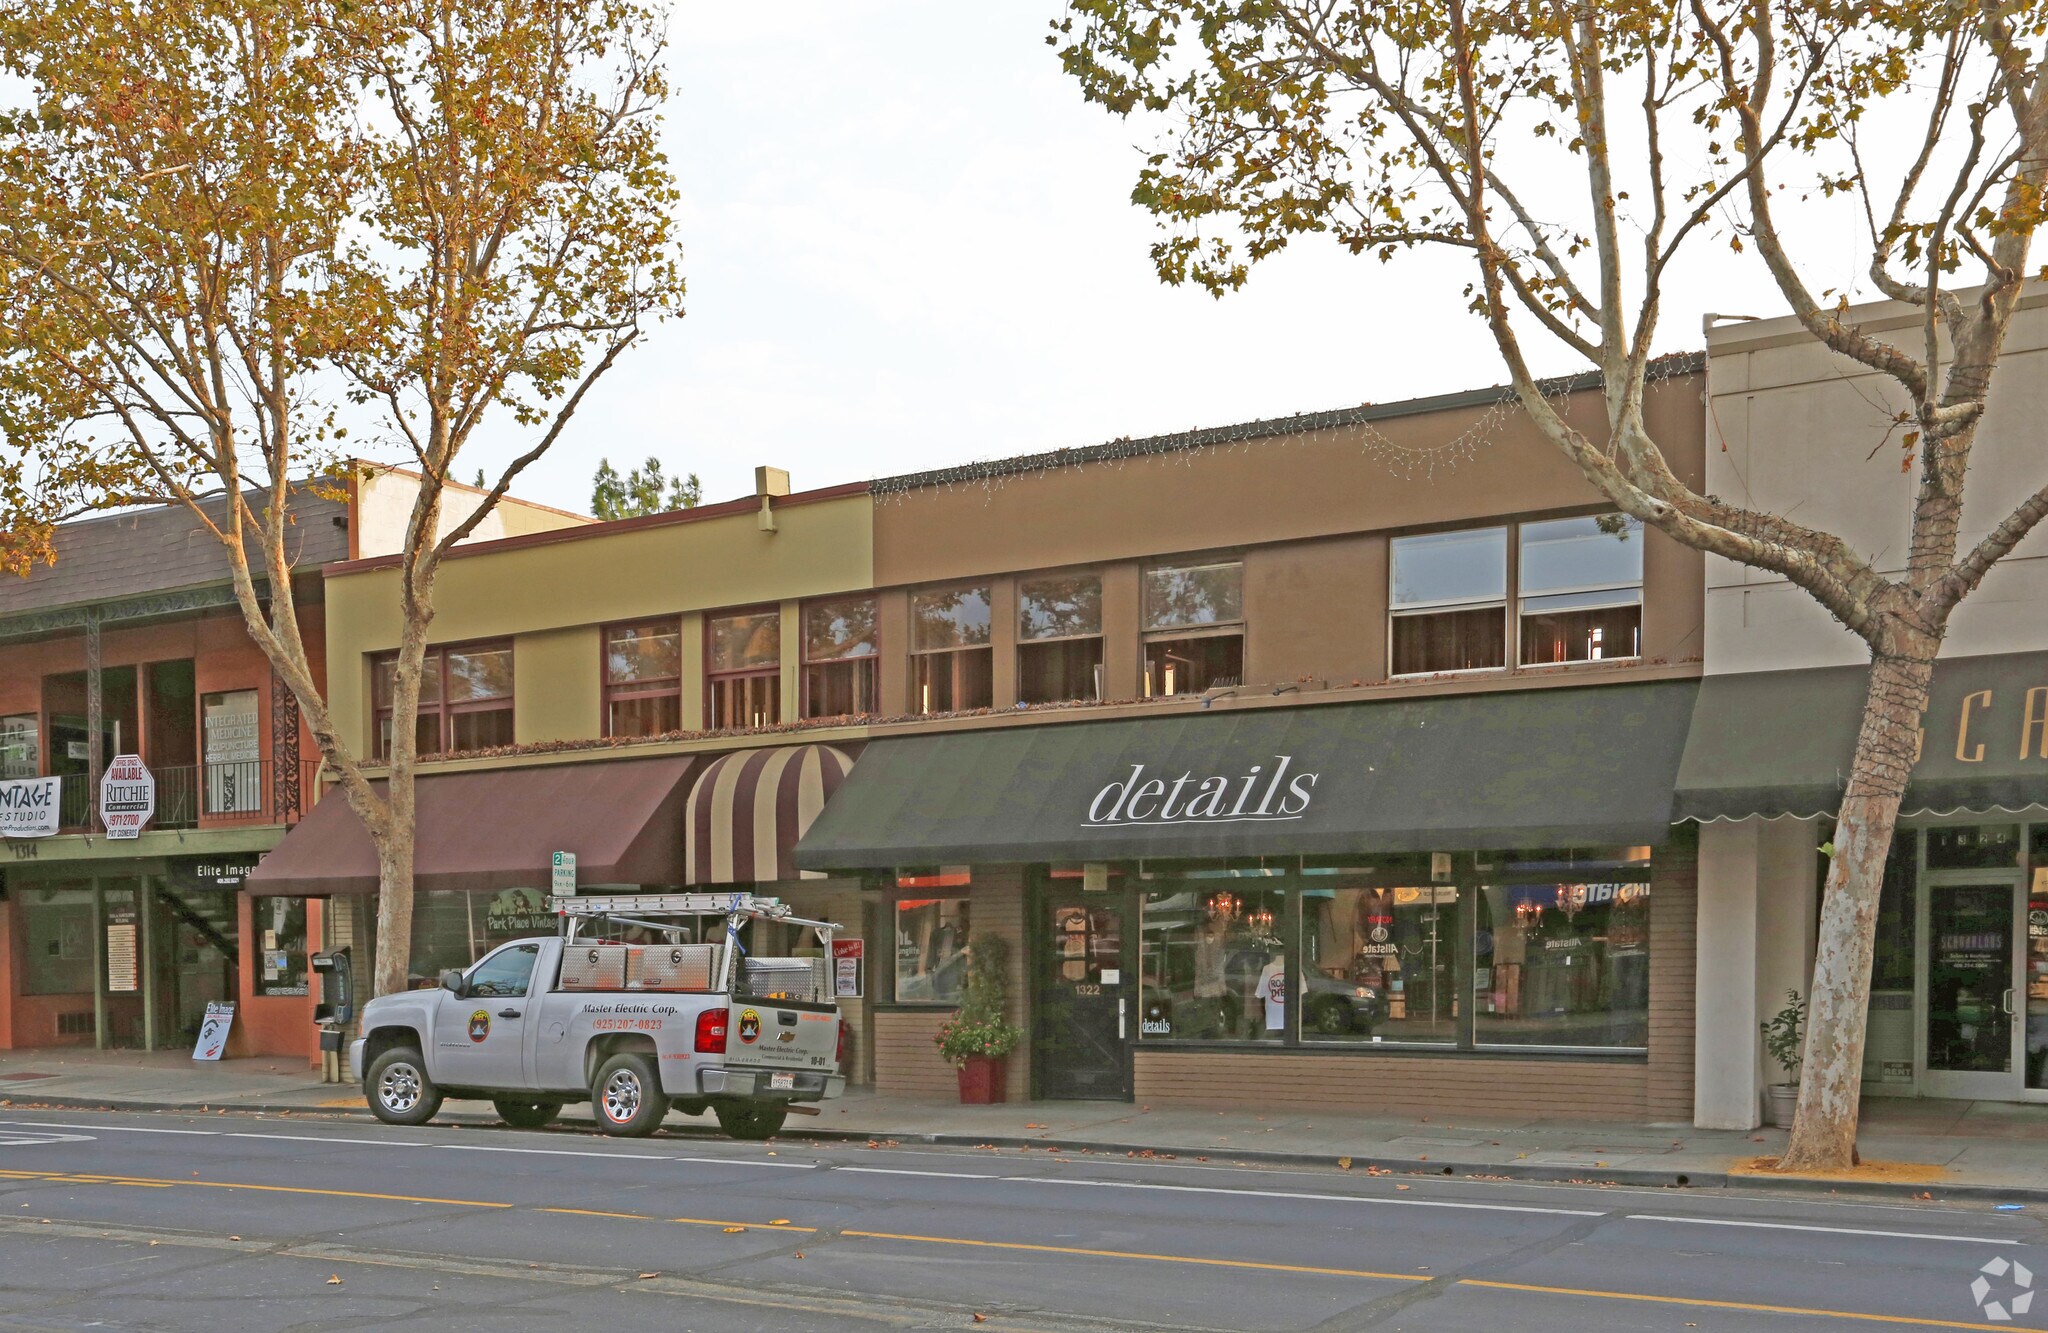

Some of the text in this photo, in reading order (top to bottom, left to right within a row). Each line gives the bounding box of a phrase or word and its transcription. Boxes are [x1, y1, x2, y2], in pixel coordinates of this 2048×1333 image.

[205, 713, 257, 728] INTEGRATED
[212, 727, 252, 740] MEDICINE
[207, 741, 258, 752] ACUPUNCTURE
[205, 751, 259, 763] HERBAL MEDICINE
[111, 768, 142, 781] AVAILABLE
[106, 783, 149, 802] RITCHIE
[1089, 755, 1319, 822] details
[0, 782, 53, 808] NTAGE
[108, 803, 146, 811] Commercial
[5, 810, 46, 821] STUDIO
[108, 828, 138, 837] PAT CISNEROS
[555, 854, 561, 865] 2
[197, 865, 221, 876] Elite
[554, 868, 575, 878] PARKING
[487, 916, 507, 930] Park
[508, 916, 530, 929] Place
[1076, 985, 1100, 995] 1322
[206, 1003, 234, 1015] Elite Image
[582, 1003, 678, 1016] Master Electric Corp.
[592, 1019, 662, 1031] (925)207-0823
[1143, 1018, 1170, 1032] details
[759, 1044, 808, 1056] Master Electric Corp.
[1884, 1067, 1912, 1076] RENT
